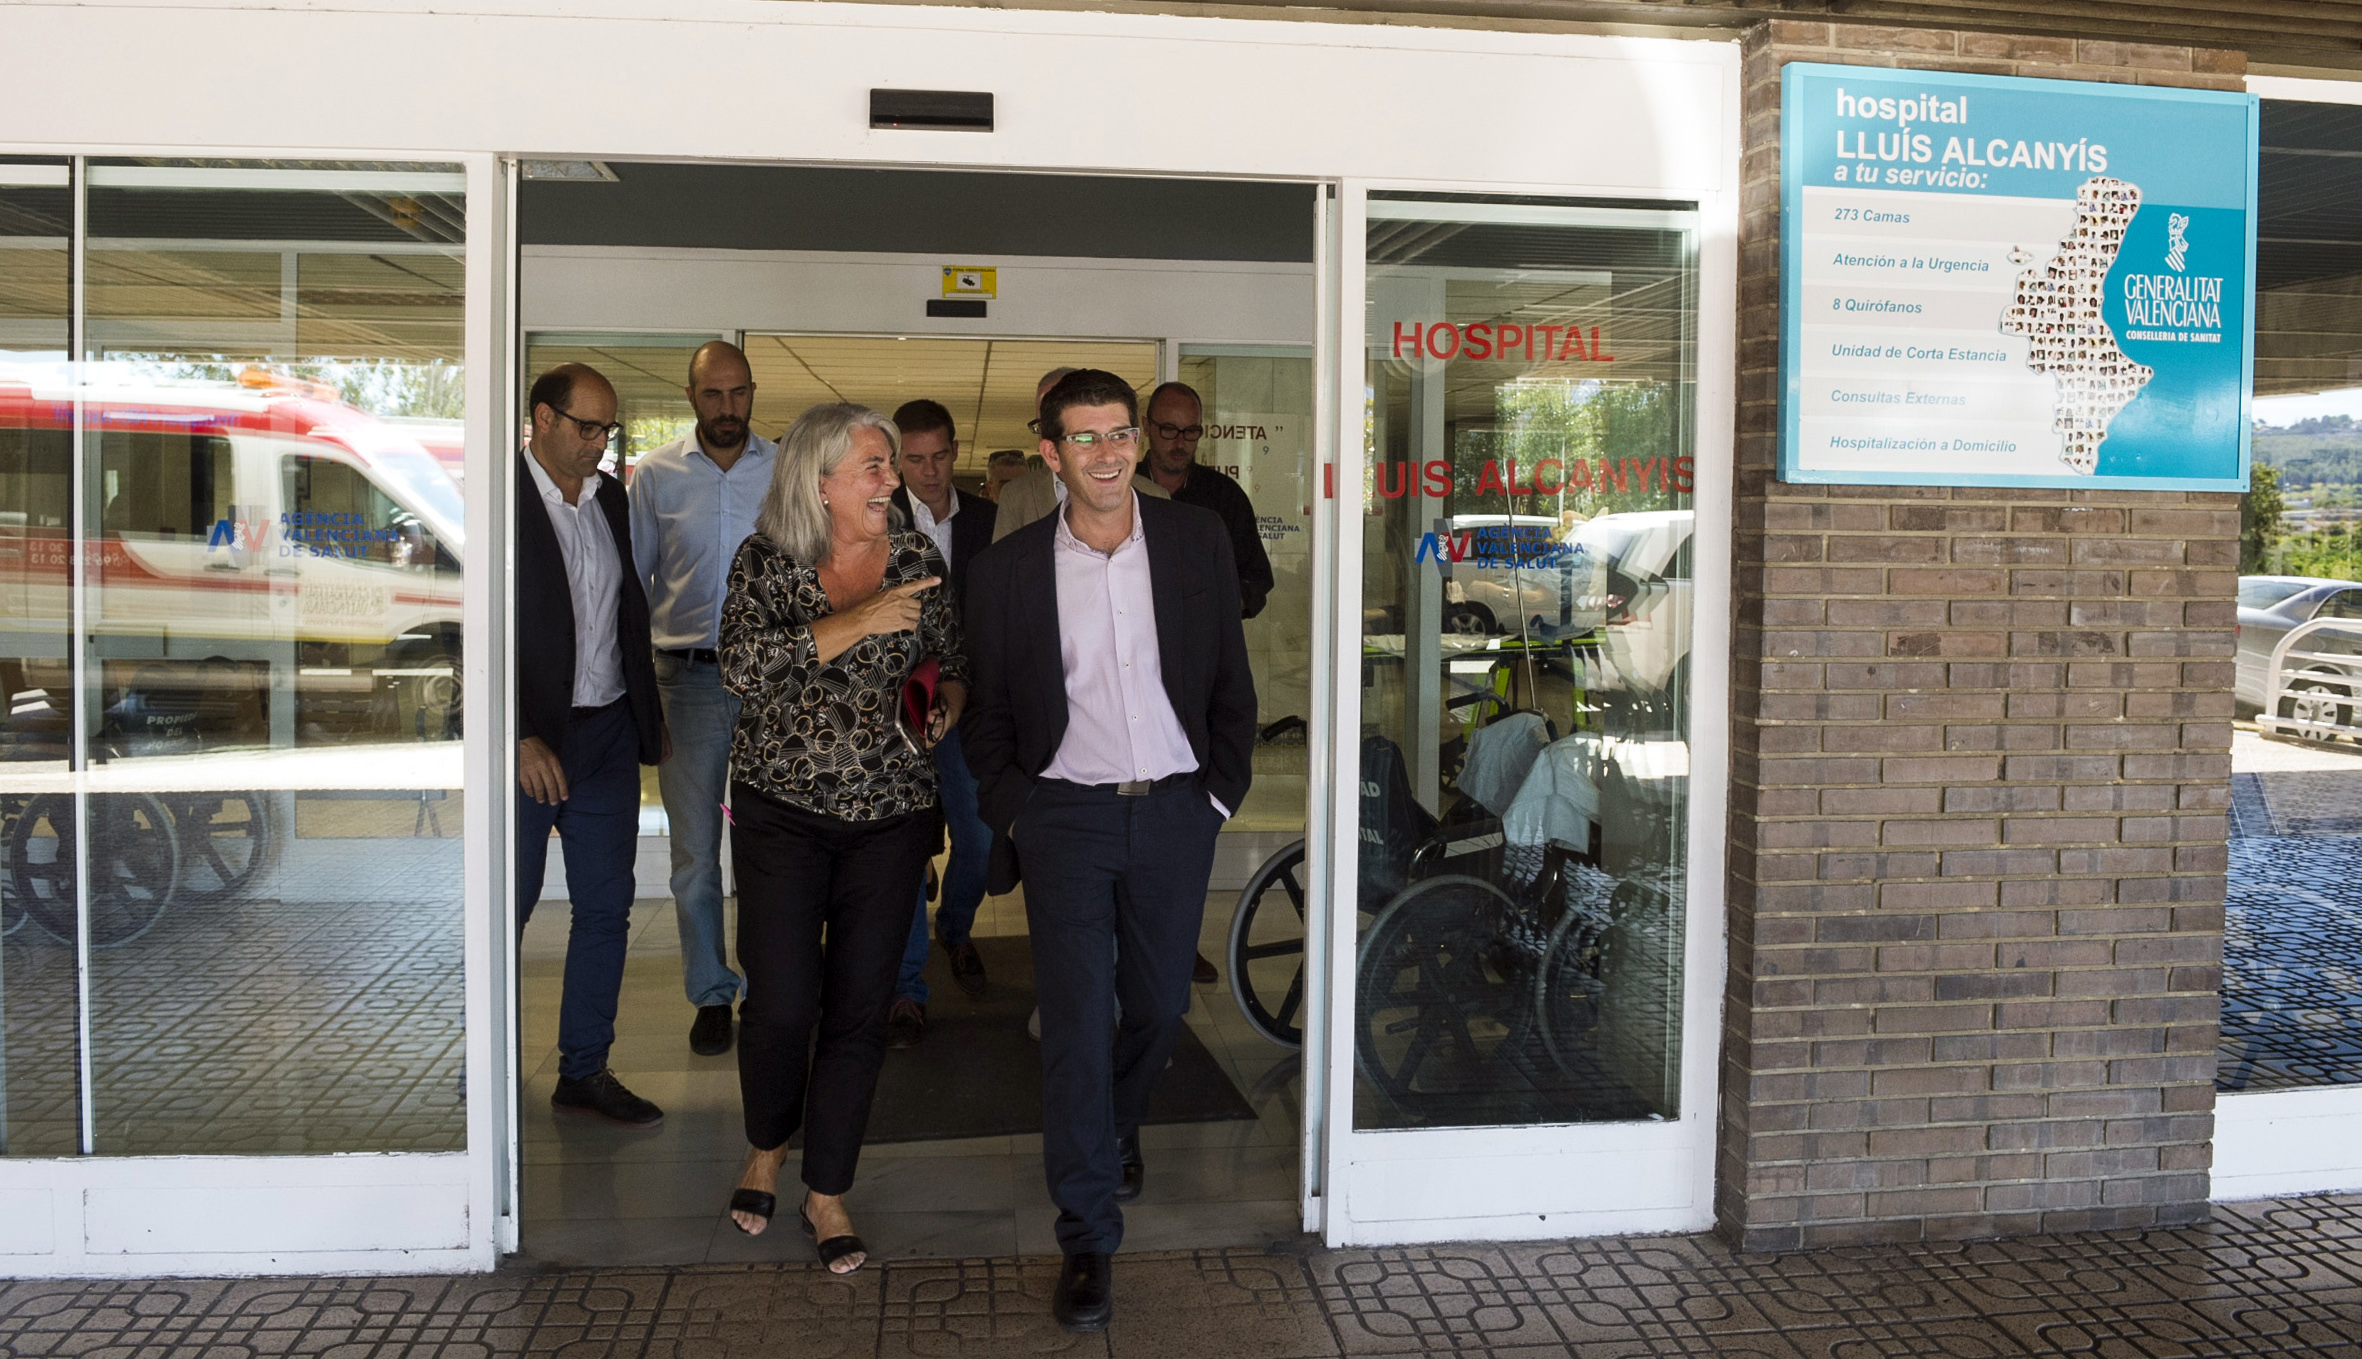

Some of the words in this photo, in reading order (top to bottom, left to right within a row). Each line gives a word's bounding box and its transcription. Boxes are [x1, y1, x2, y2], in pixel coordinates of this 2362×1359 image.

[1836, 87, 1967, 128] hospital
[1836, 127, 1932, 163] LLUÍS
[1941, 137, 2108, 173] ALCANYÍS
[1833, 164, 1849, 181] a
[1855, 162, 1878, 183] tu
[1885, 165, 1988, 189] servicio:
[1834, 207, 1859, 221] 273
[1863, 209, 1911, 223] Camas
[1833, 252, 1896, 268] Atención
[1899, 257, 1908, 268] a
[1911, 256, 1924, 269] la
[1928, 257, 1990, 273] Urgencia
[2124, 273, 2223, 303] GENERALITAT
[1832, 297, 1841, 310] 8
[1845, 297, 1923, 314] Quirófanos
[2124, 299, 2222, 328] VALENCIANA
[1392, 320, 1615, 362] HOSPITAL
[2125, 330, 2177, 342] CONSELLERIA
[2179, 331, 2188, 342] DE
[2190, 332, 2222, 343] SANITAT
[1831, 343, 1882, 358] Unidad
[1885, 345, 1902, 359] de
[1906, 346, 1944, 360] Corta
[1948, 347, 2007, 362] Estancia
[1831, 389, 1901, 404] Consultas
[1905, 391, 1967, 406] Externas
[1829, 435, 1937, 452] Hospitalización
[1940, 440, 1949, 450] a
[1952, 438, 2018, 453] Domicilio
[1475, 456, 1695, 497] ALCANYIS
[279, 528, 401, 543] VALENCIANA
[1477, 522, 1553, 539] AGÈNCIA
[279, 545, 304, 558] DE
[308, 545, 369, 558] SALUT
[1477, 542, 1585, 555] VALENCIANA
[1477, 557, 1496, 569] DE
[1504, 557, 1558, 570] SALUT
